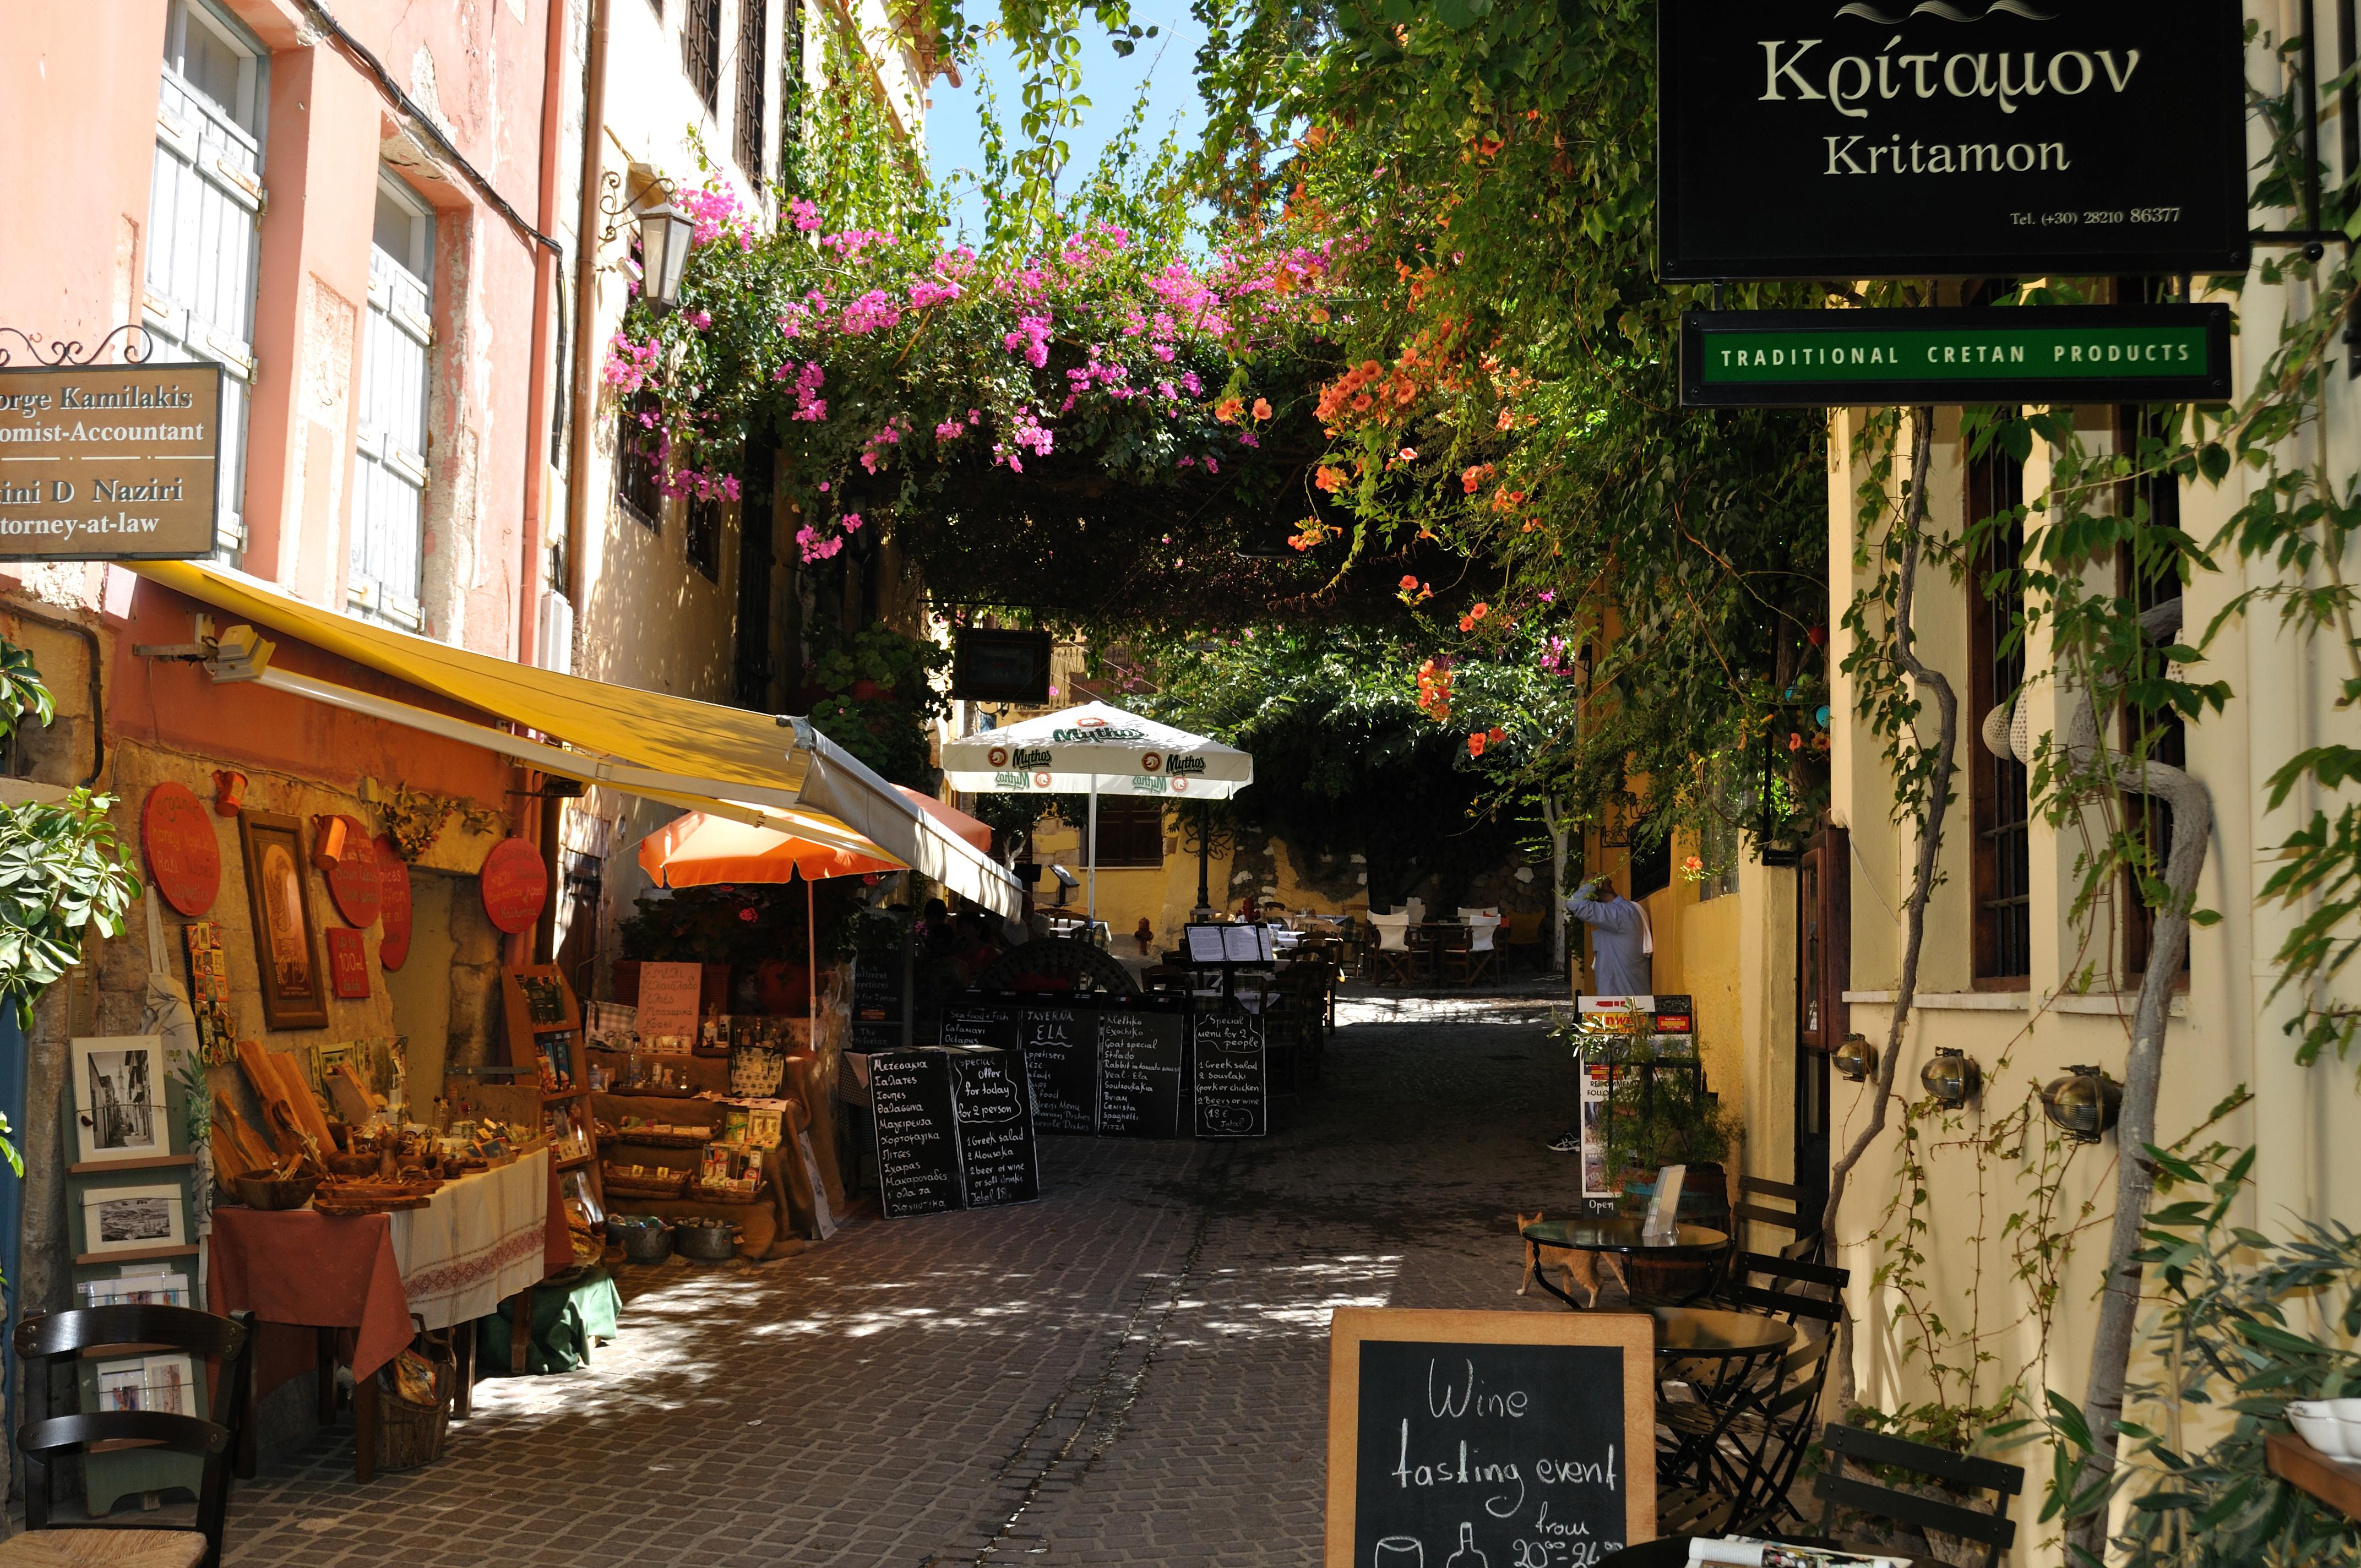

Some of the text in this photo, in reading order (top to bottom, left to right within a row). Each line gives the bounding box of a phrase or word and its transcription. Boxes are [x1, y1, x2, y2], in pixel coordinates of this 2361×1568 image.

[1757, 35, 2140, 118] Κρίταμον
[1823, 134, 2071, 175] Kritamon
[2010, 207, 2180, 226] Tel. (+30) 28210 86377
[1721, 343, 2190, 367] TRADITIONAL CRETAN PRODUCTS
[0, 385, 193, 418] orge Kamilakis
[0, 421, 204, 442] omist-Accountant
[51, 481, 75, 504] D
[93, 477, 184, 503] Naziri
[0, 511, 159, 541] torney-at-law
[1053, 727, 1147, 742] Mythos
[1013, 748, 1053, 770] Mythos
[1166, 753, 1206, 776] Mythos
[150, 824, 181, 852] honey
[380, 870, 401, 883] pices
[168, 877, 209, 903] Cosmetics
[1223, 1027, 1237, 1039] for
[1239, 1028, 1247, 1039] 2
[1223, 1036, 1259, 1050] people
[1026, 1049, 1065, 1061] ppetisers
[1103, 1059, 1130, 1069] Rabbit
[1199, 1071, 1205, 1080] 2
[1234, 1060, 1258, 1071] salad
[965, 1080, 1010, 1098] for today
[958, 1102, 1012, 1119] for 2 person
[998, 1126, 1024, 1143] salad
[975, 1164, 993, 1175] beer
[1588, 1199, 1614, 1215] Open
[1429, 1358, 1528, 1418] Wine
[1391, 1418, 1617, 1518] tasting event
[1535, 1501, 1590, 1536] from
